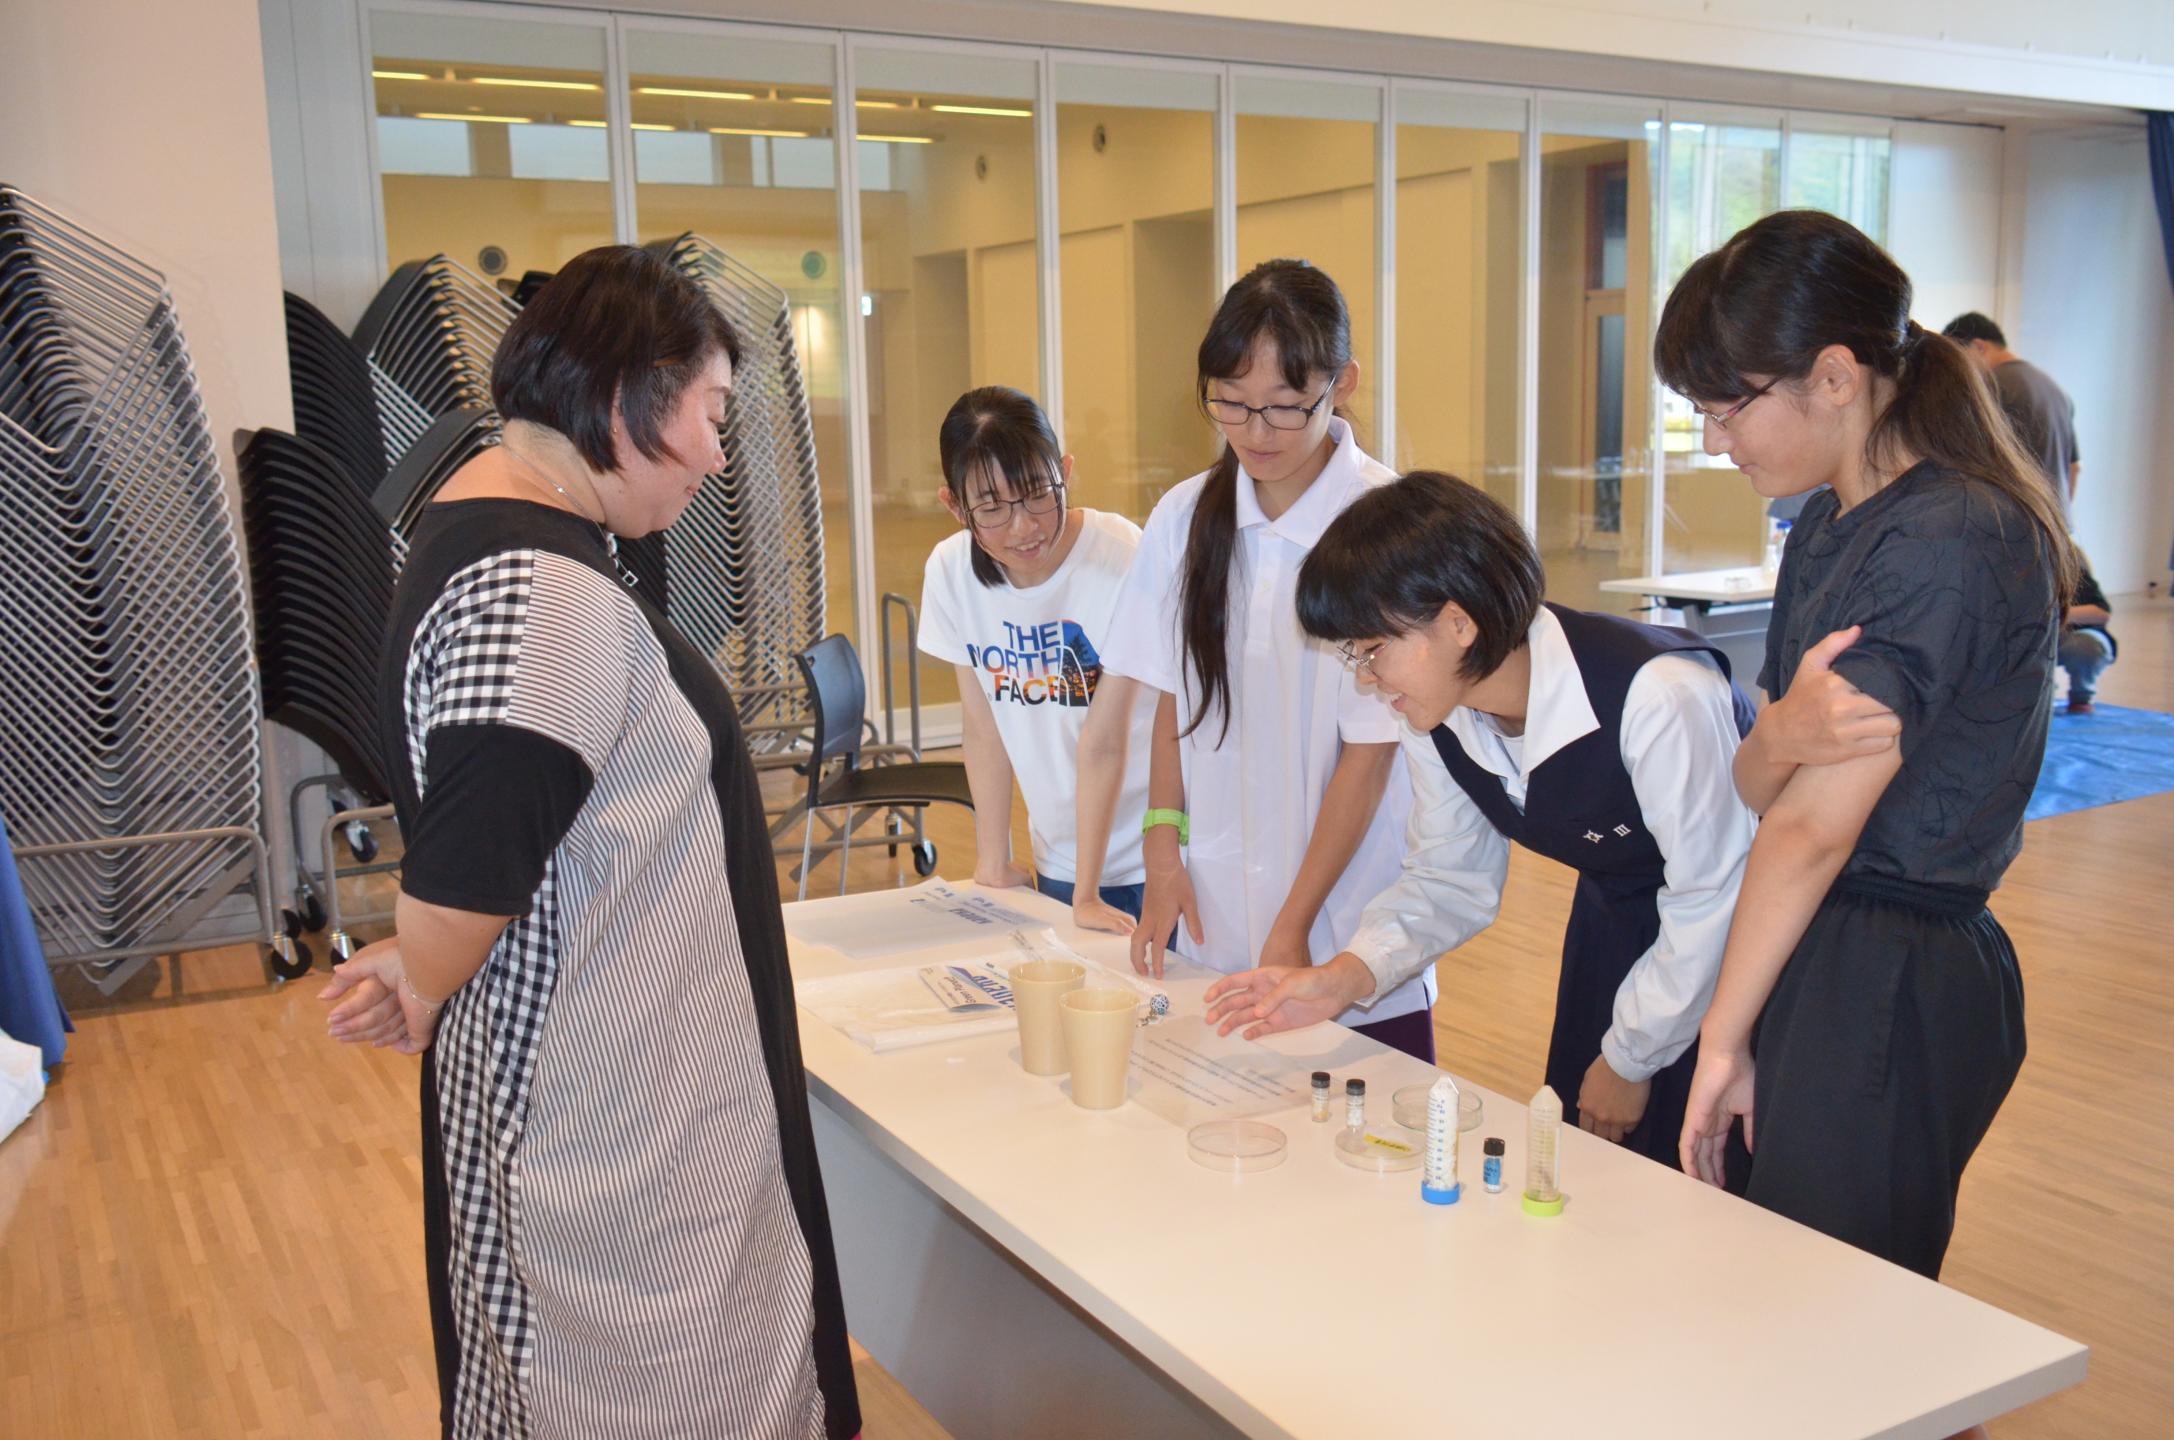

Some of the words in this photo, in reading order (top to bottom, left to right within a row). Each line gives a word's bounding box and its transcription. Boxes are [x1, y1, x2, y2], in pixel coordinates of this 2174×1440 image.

[1003, 621, 1060, 651] THE
[966, 643, 1061, 678] NORTH
[994, 674, 1059, 706] FACE
